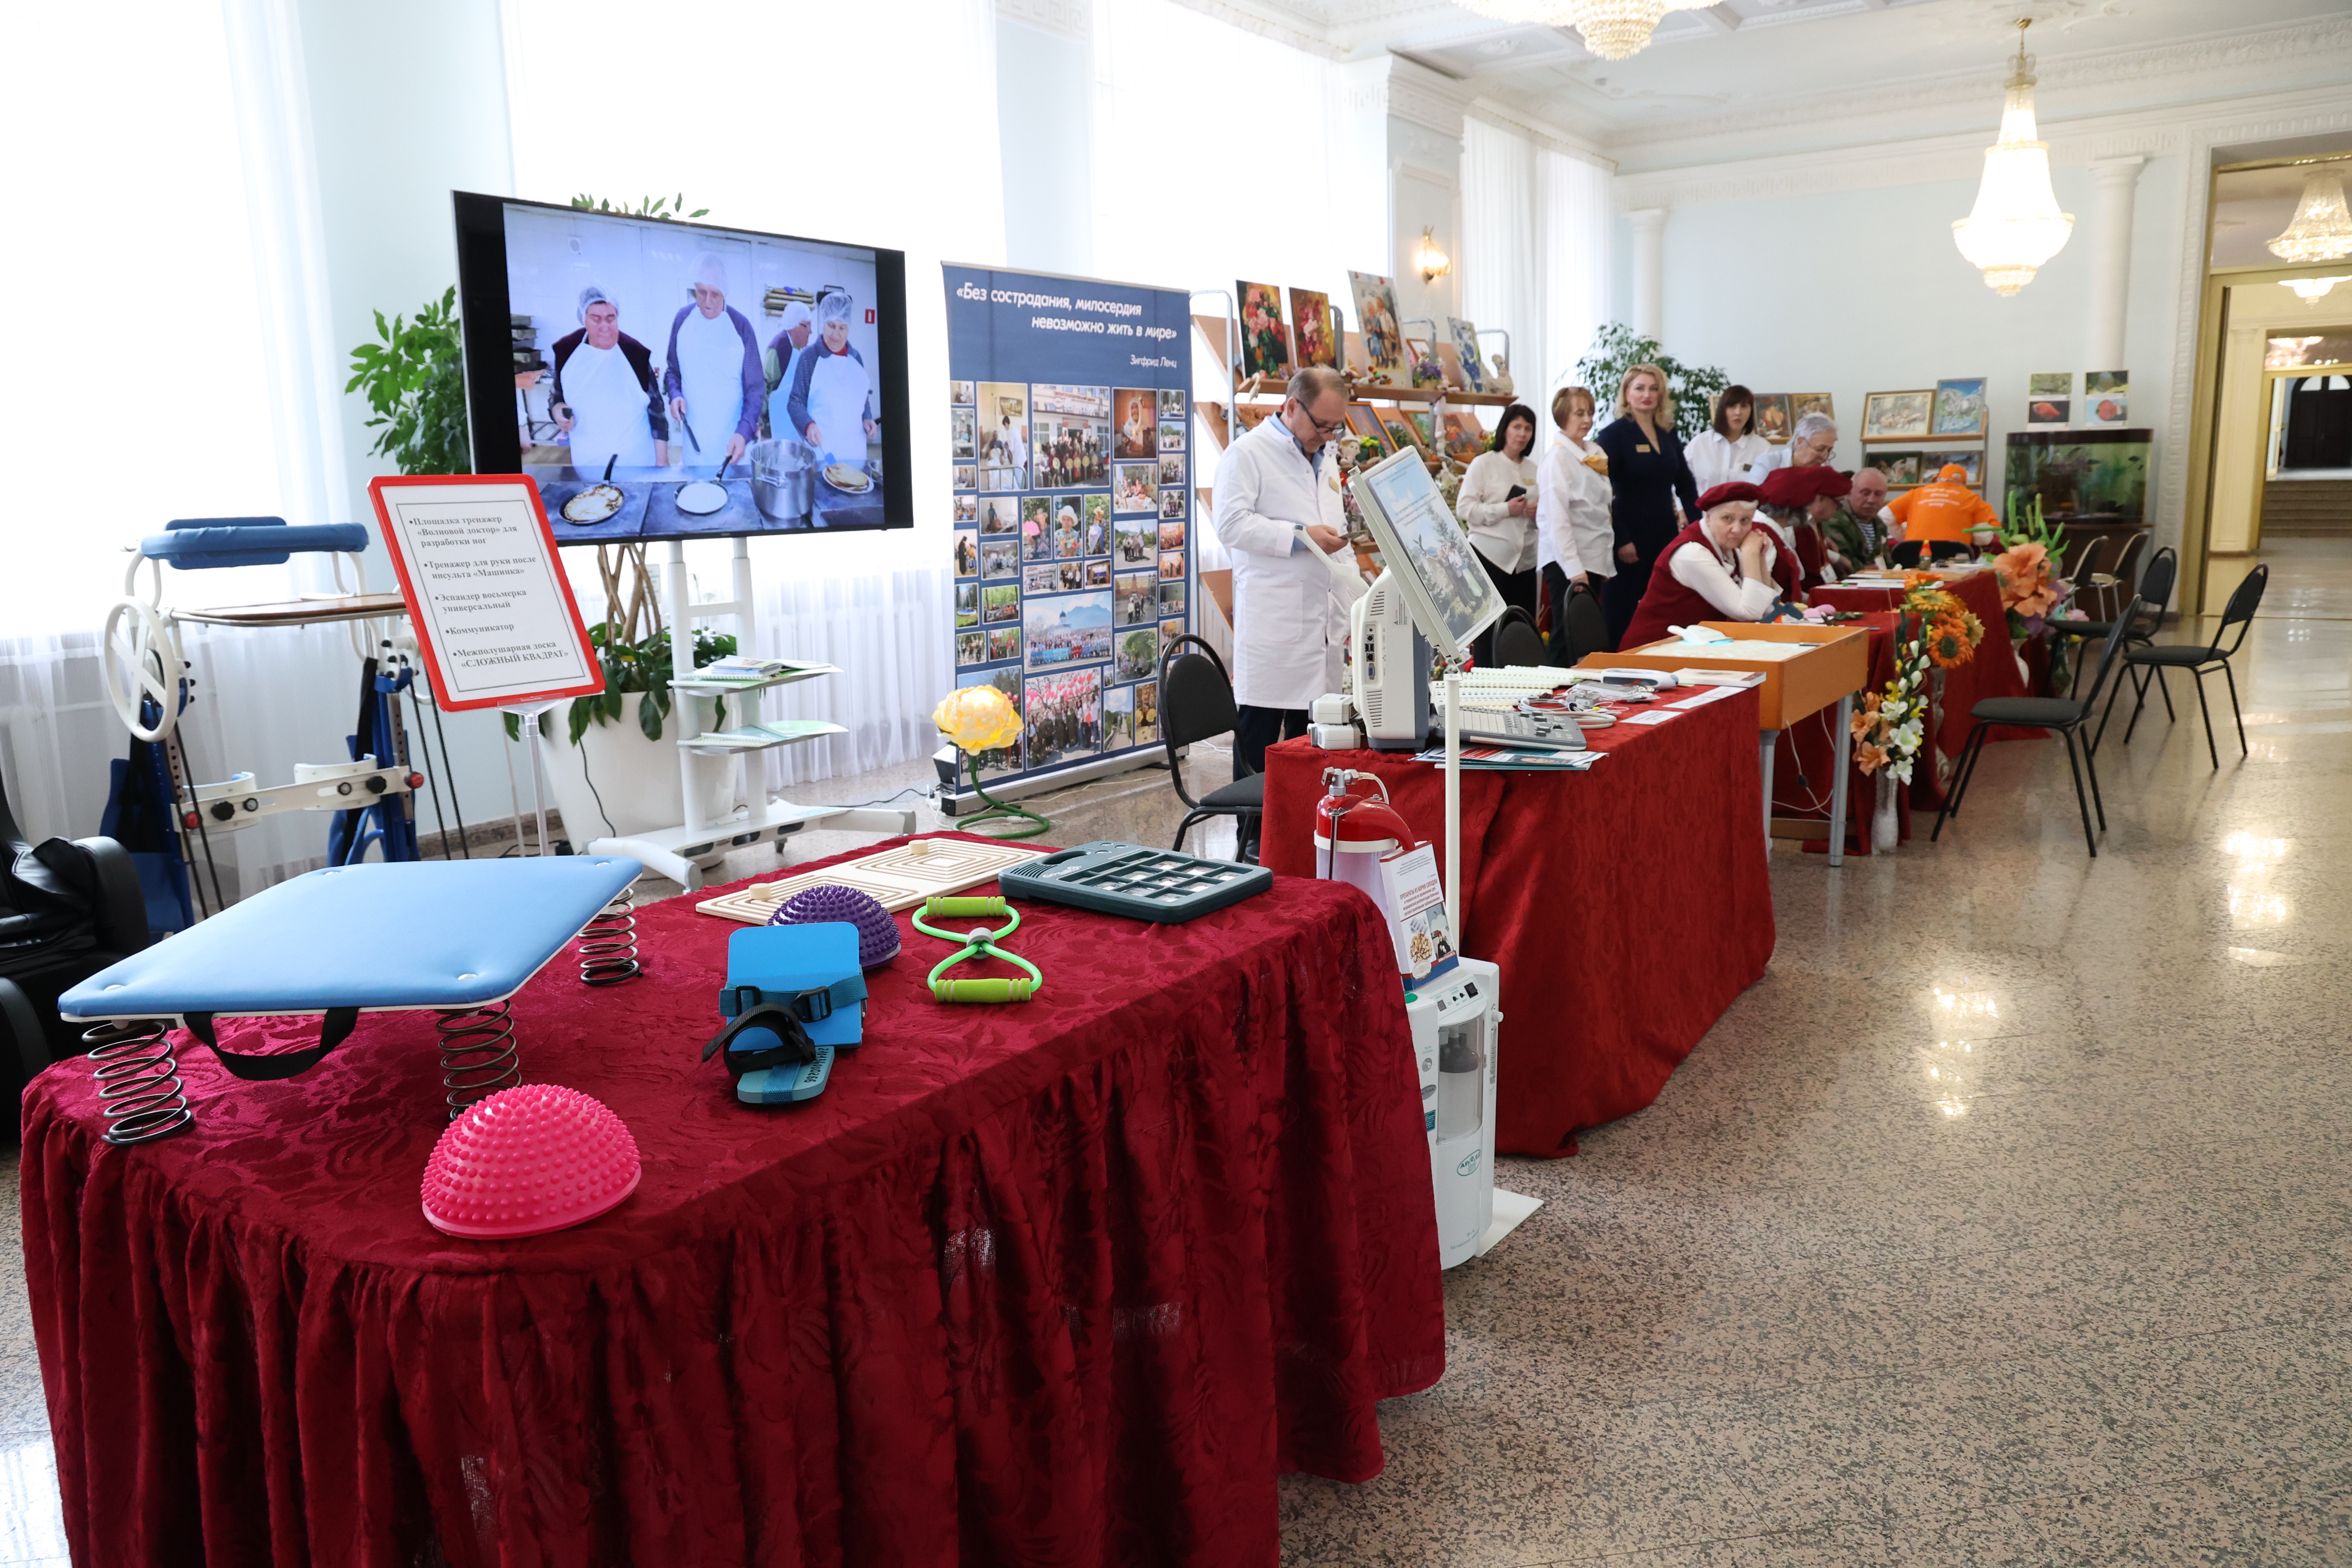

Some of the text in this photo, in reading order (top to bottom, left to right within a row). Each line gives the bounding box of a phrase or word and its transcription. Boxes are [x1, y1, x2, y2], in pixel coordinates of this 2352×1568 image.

[956, 282, 1142, 316] «Без сострадания, милосердия
[1032, 315, 1177, 342] невозможно жить в мире»
[1130, 355, 1177, 368] Зигфрид Ленц
[413, 515, 502, 526] Площадка тренажер
[417, 527, 465, 536] «Волновой
[467, 527, 501, 536] доктор»
[421, 537, 470, 548] разработки
[427, 556, 536, 570] Тренажер для руки после
[432, 568, 524, 580] инсульта «Машинка»
[438, 588, 527, 603] Эспандер восьмерка
[442, 601, 511, 614] универсальный
[450, 623, 514, 635] Коммуникатор
[457, 645, 531, 658] Межполушарная
[461, 650, 569, 668] «СЛОЖНЫЙ КВАДРАТ»
